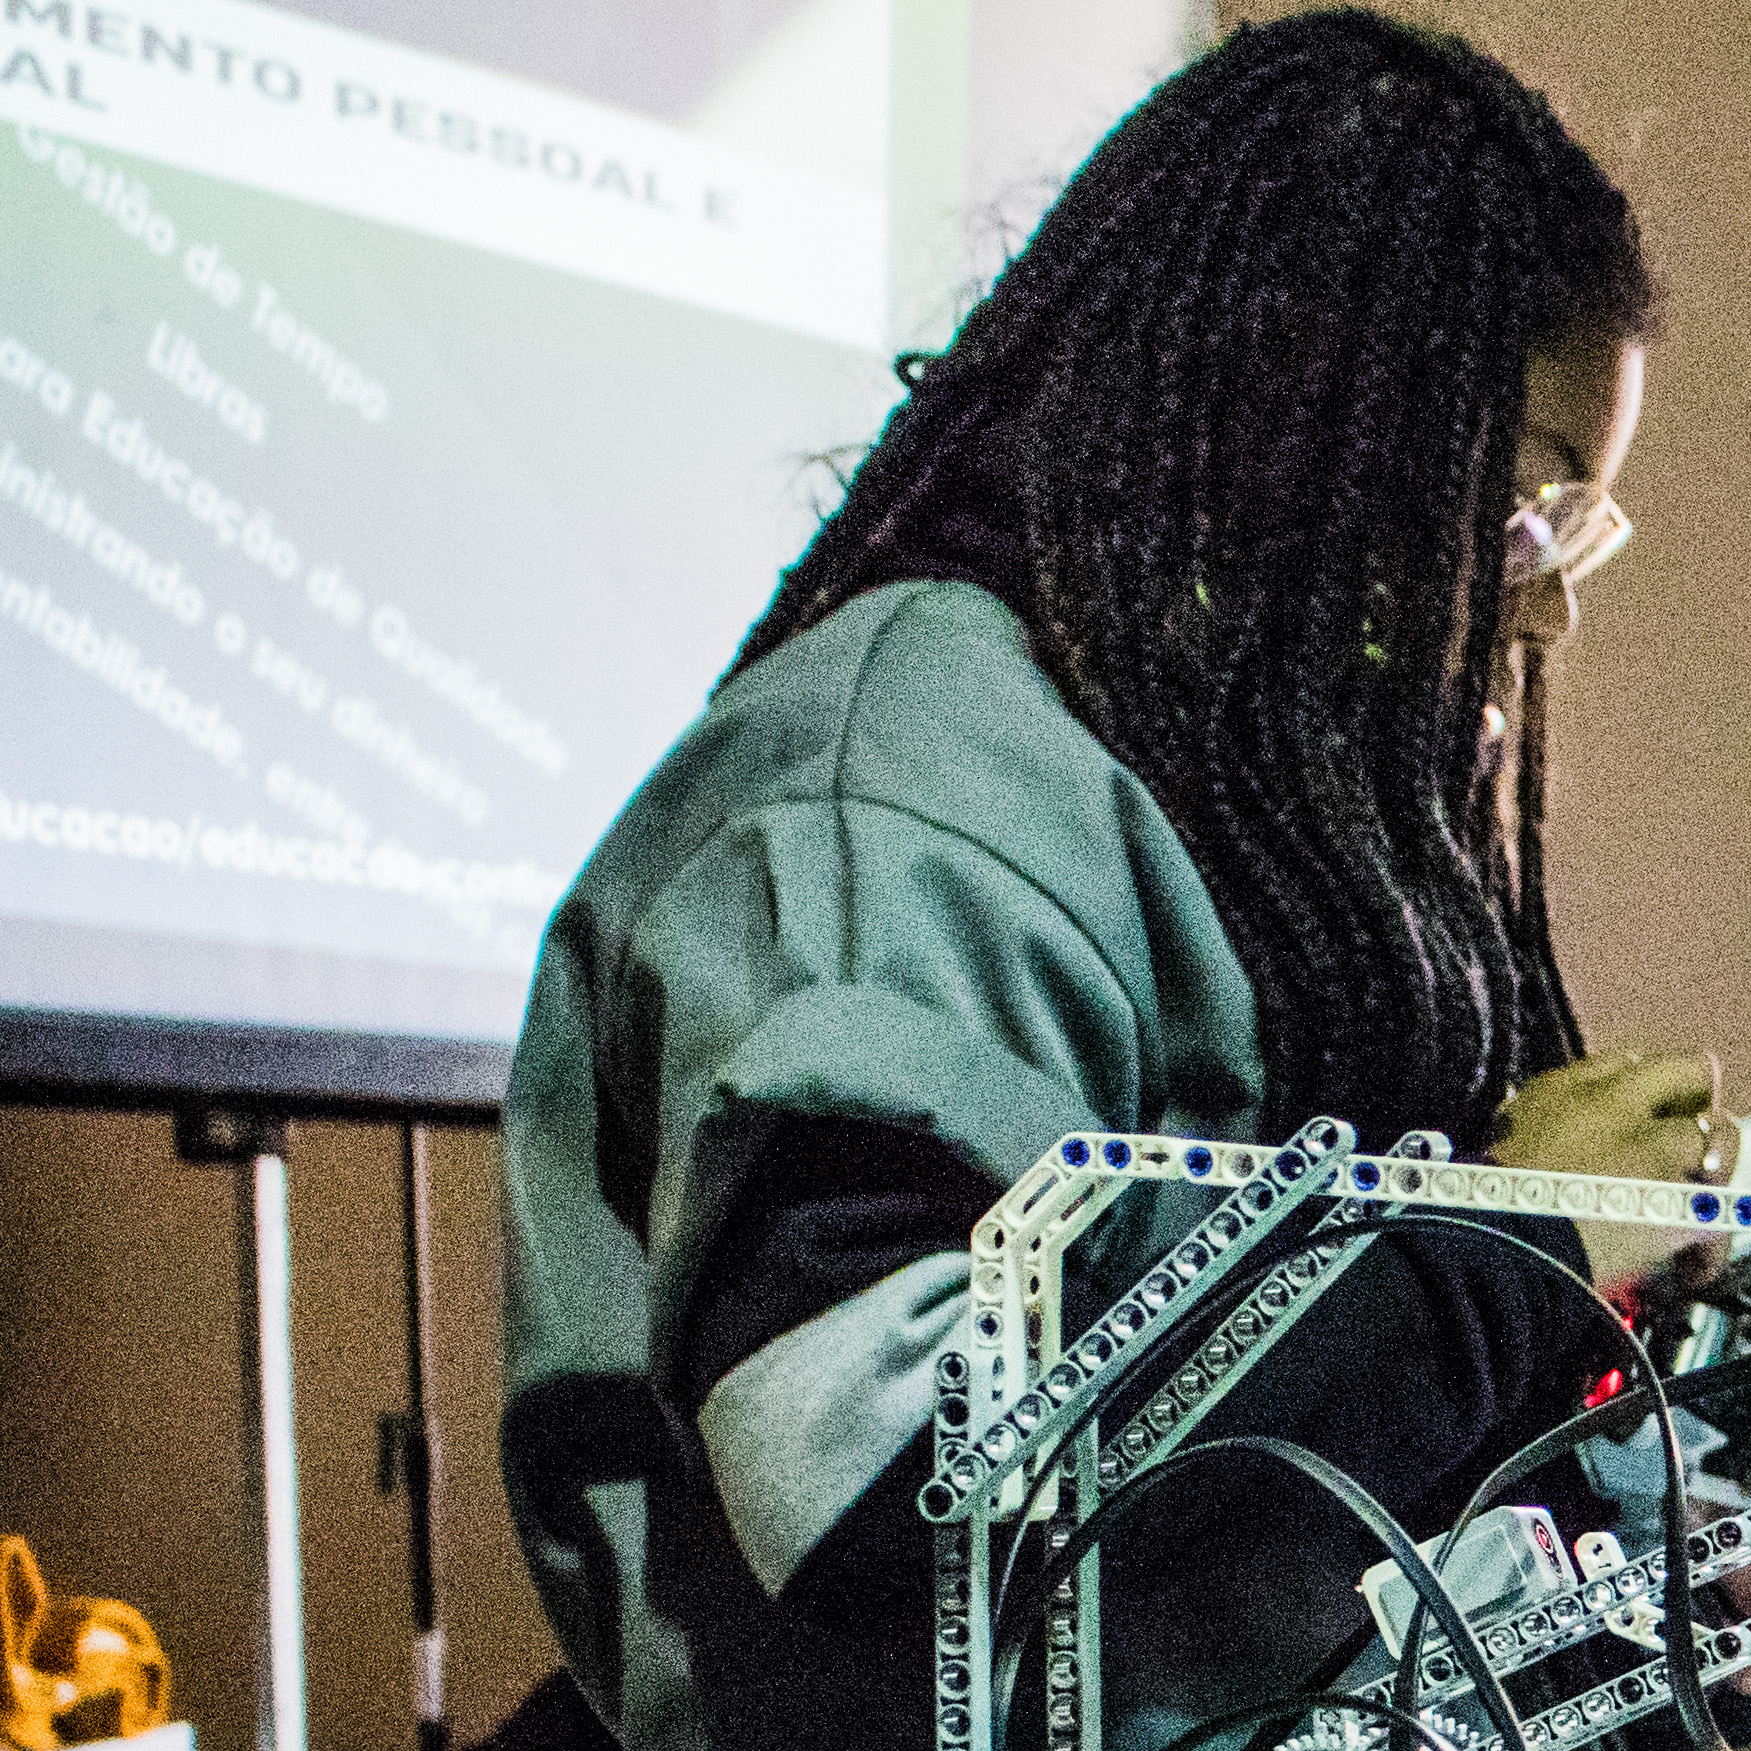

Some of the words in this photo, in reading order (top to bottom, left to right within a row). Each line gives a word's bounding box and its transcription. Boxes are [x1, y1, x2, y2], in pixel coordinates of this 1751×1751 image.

[0, 48, 110, 114] AL
[0, 0, 305, 104] MENTO
[336, 78, 680, 217] PESSOAL
[704, 185, 740, 232] E
[145, 317, 268, 445] Libras
[183, 242, 242, 310] de
[250, 284, 390, 423] Tempo
[82, 388, 300, 580] Educação
[306, 560, 364, 628] de
[213, 609, 247, 657] o
[250, 636, 329, 714] seu
